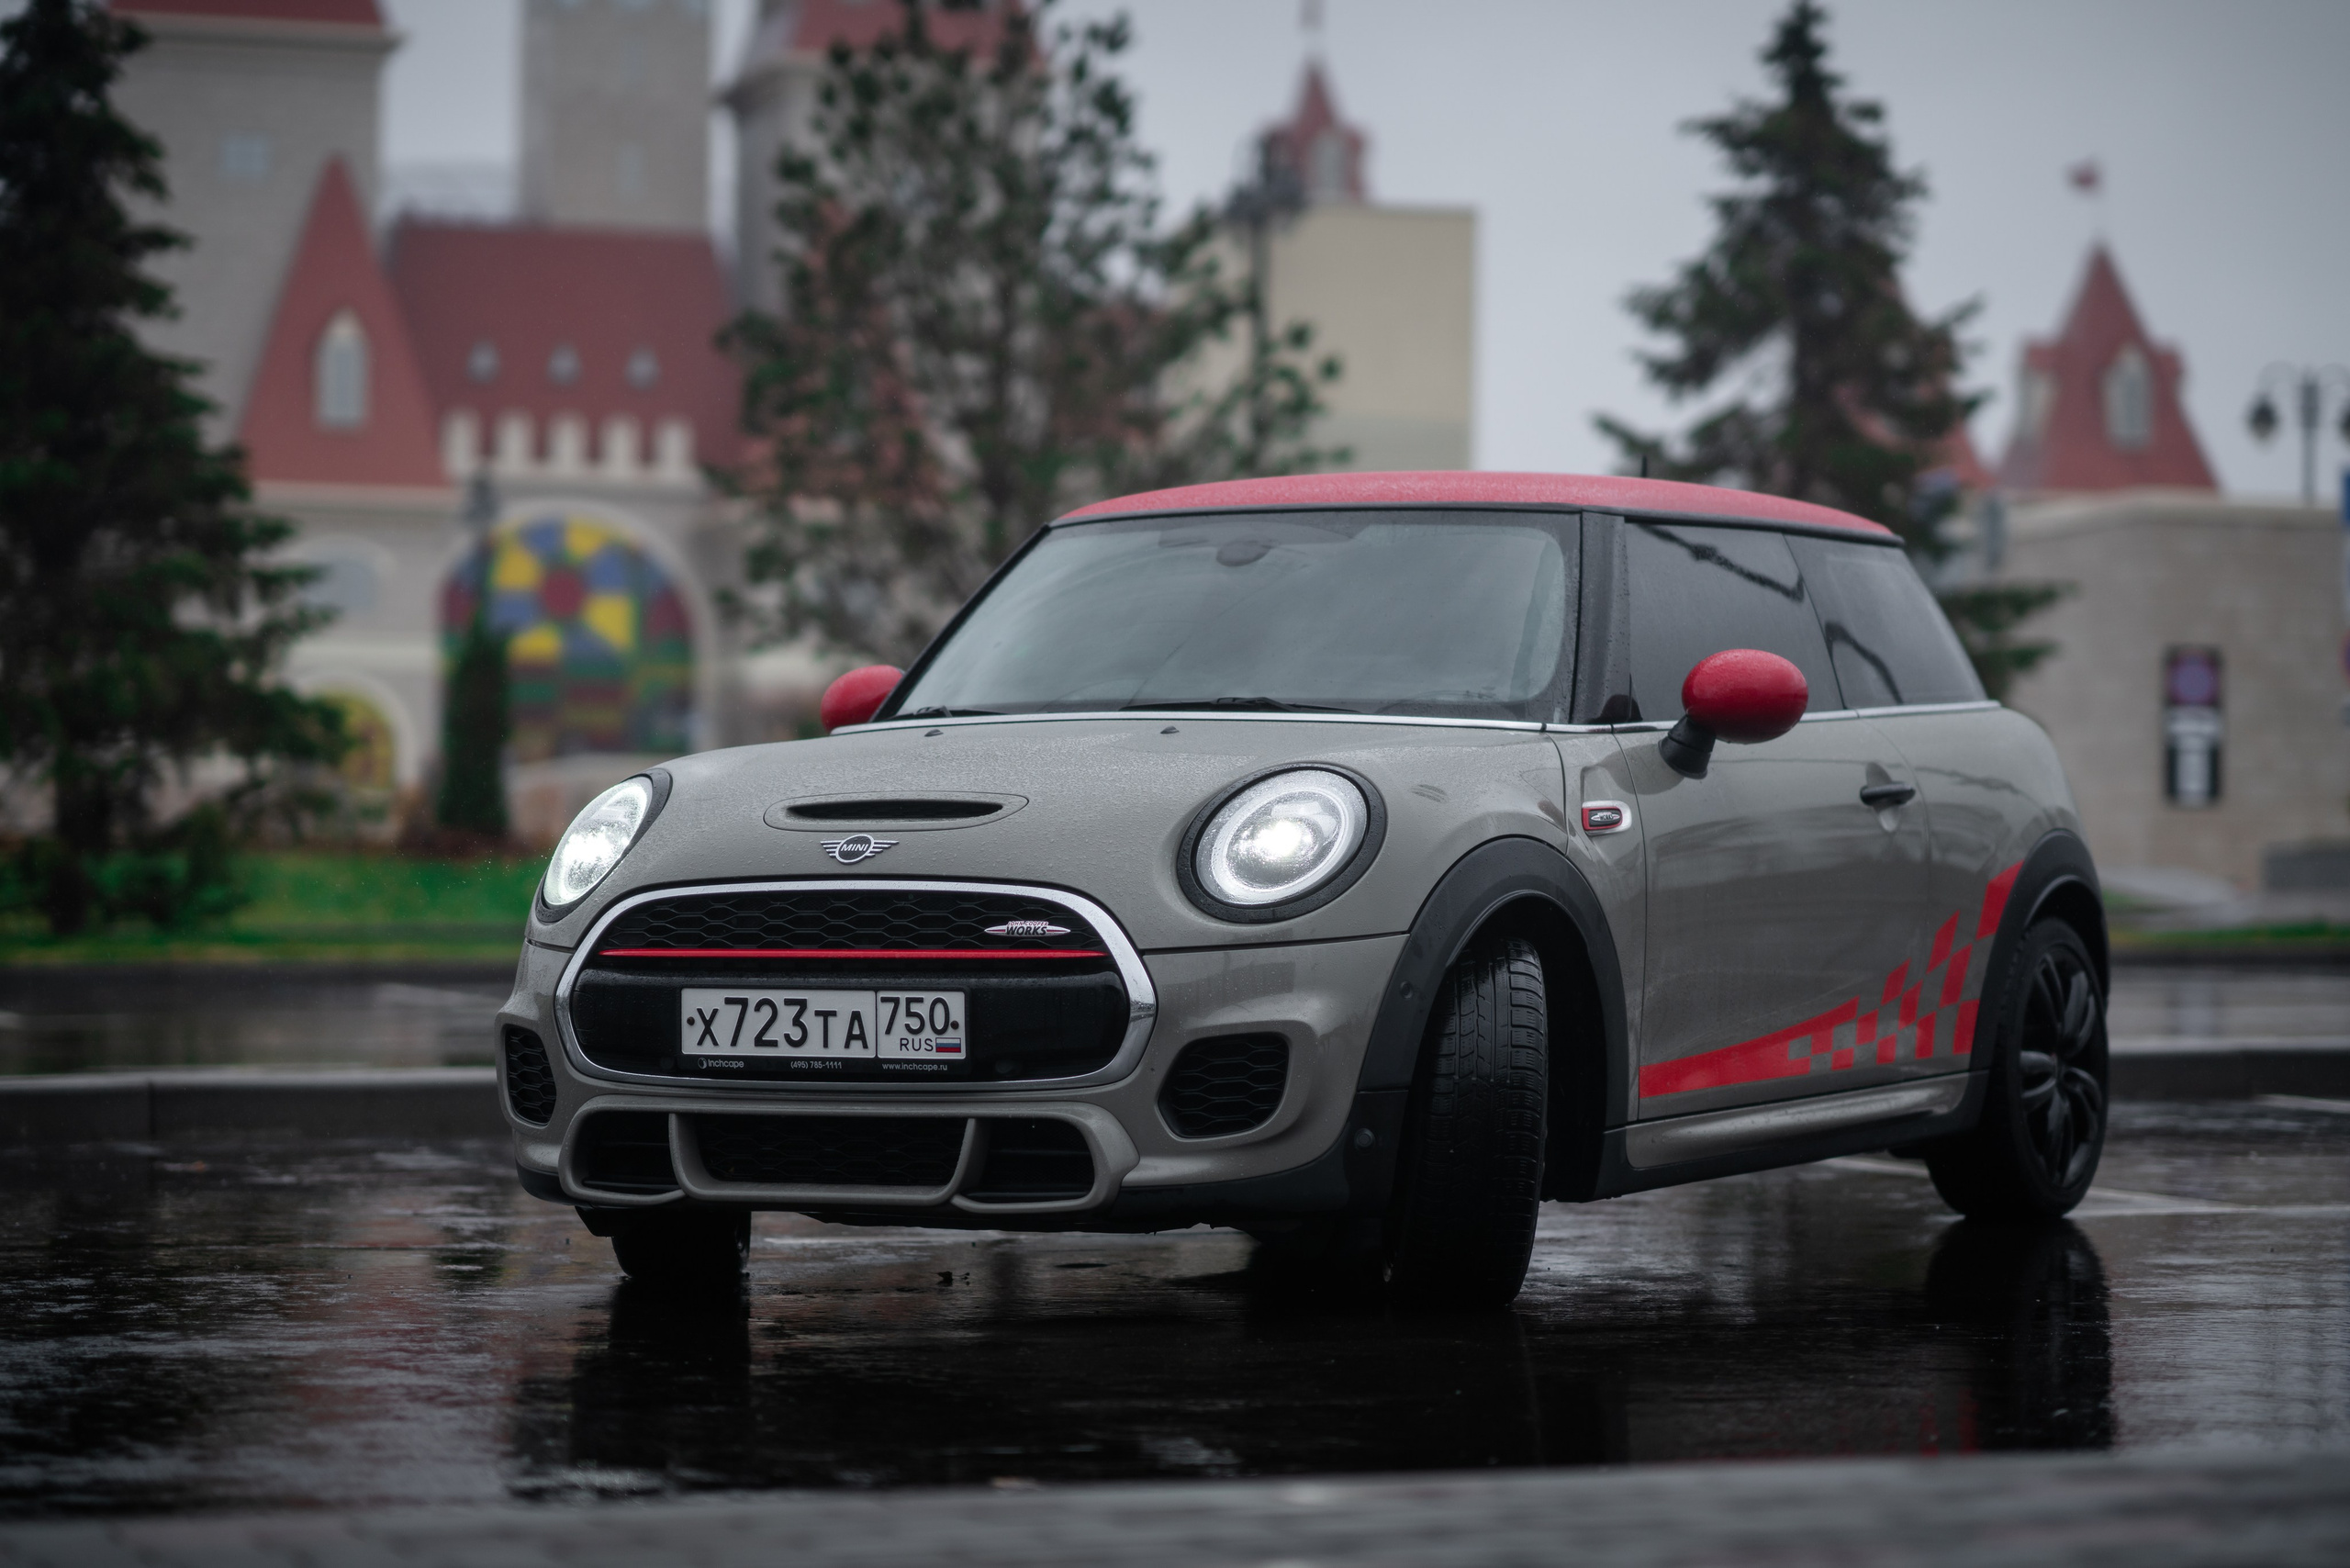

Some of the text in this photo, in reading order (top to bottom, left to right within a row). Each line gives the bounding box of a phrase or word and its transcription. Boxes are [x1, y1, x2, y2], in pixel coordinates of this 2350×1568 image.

[840, 844, 868, 852] MINI
[1006, 926, 1047, 935] WORKS
[880, 996, 950, 1035] 750
[900, 1037, 934, 1052] RUS
[708, 1058, 744, 1070] Inchcape
[790, 1060, 843, 1070] (495) 785-1111
[882, 1061, 948, 1072] www.inchcape.ru
